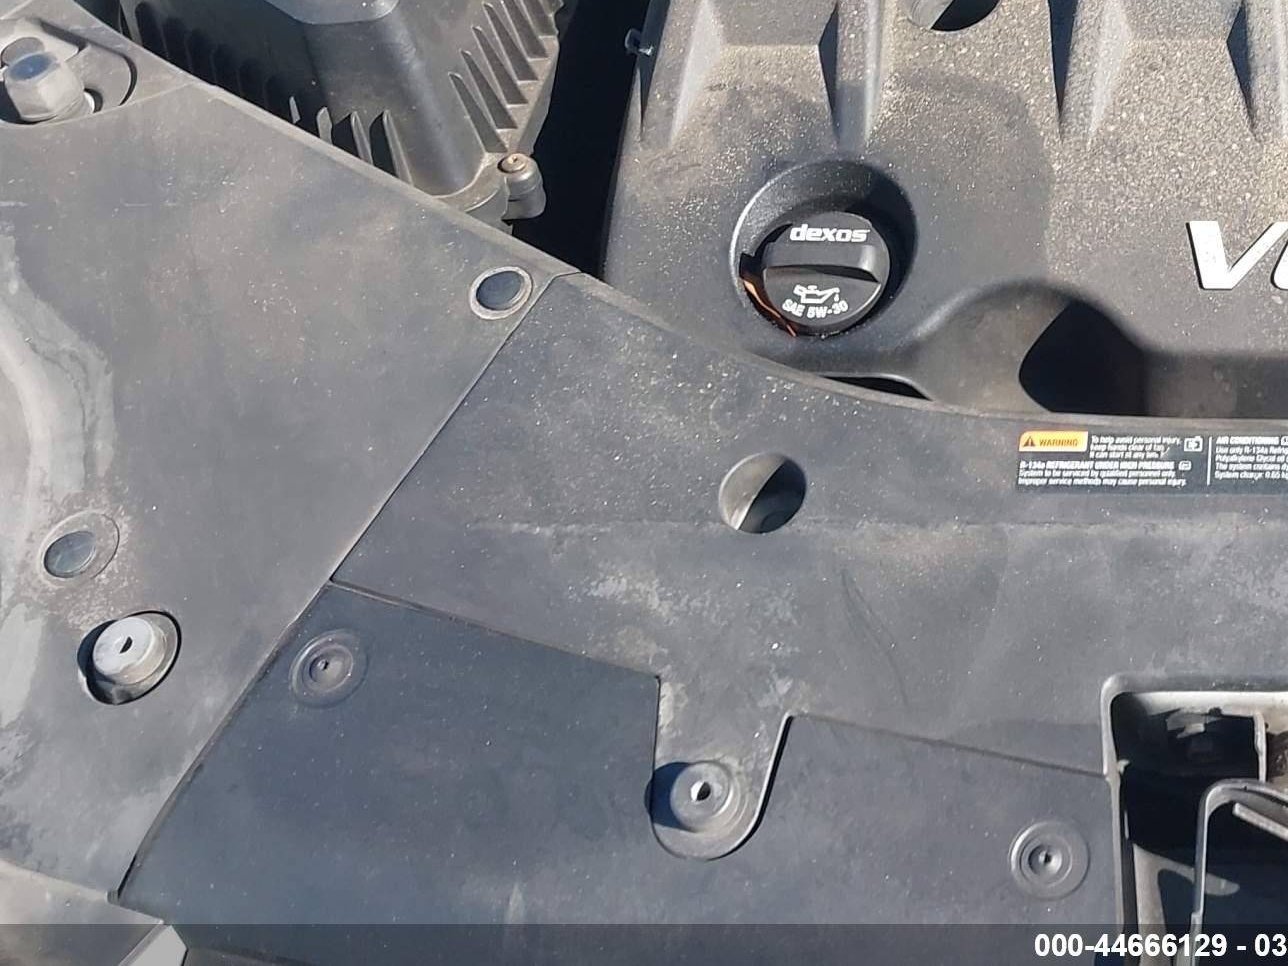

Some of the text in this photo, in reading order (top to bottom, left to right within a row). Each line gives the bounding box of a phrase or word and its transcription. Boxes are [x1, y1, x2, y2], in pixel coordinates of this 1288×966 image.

[789, 223, 870, 242] dexos
[782, 299, 848, 318] SAE 5W-30
[1040, 439, 1079, 447] WARNING
